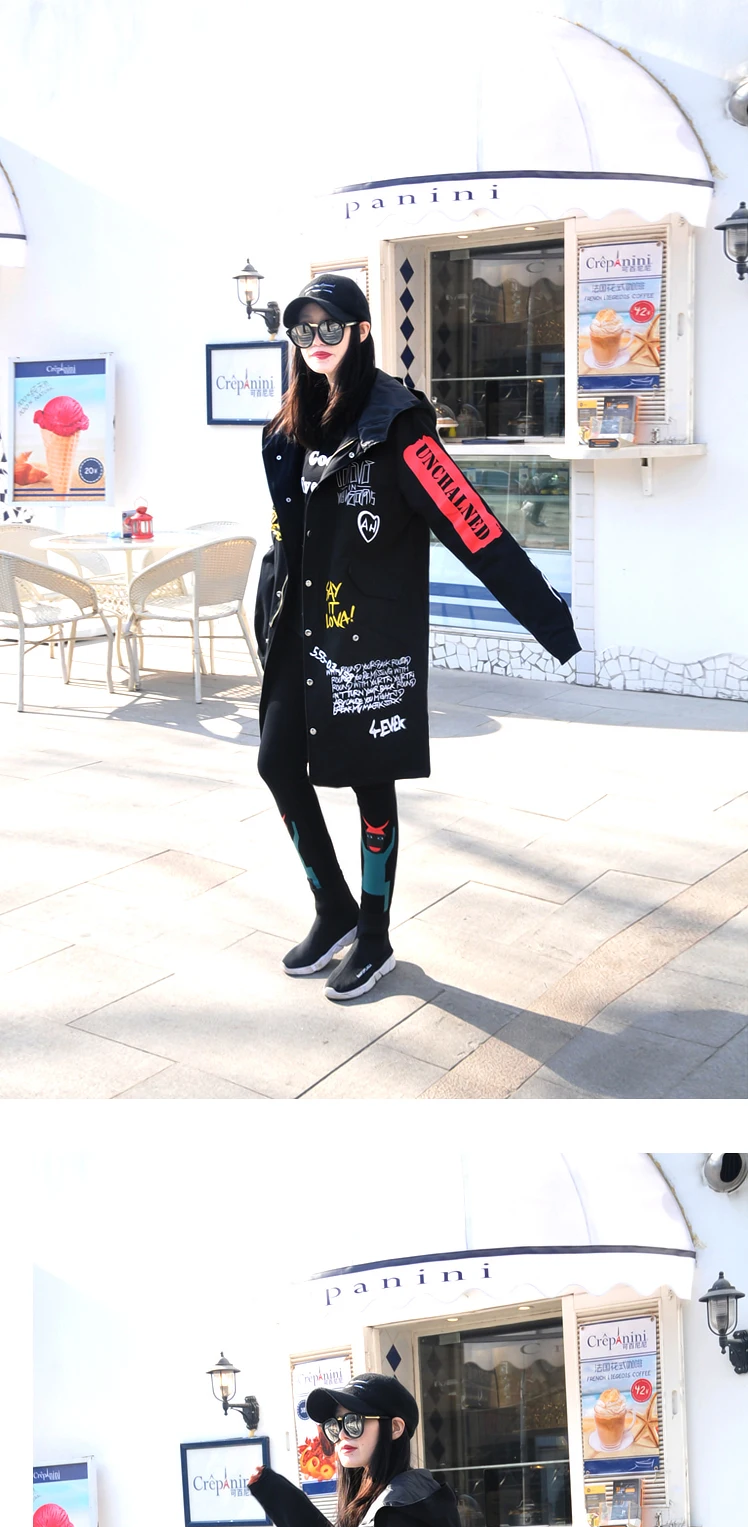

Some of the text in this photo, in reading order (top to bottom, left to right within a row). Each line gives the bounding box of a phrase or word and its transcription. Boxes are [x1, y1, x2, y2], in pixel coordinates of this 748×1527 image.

[345, 185, 500, 219] panini
[415, 443, 490, 540] UNCHALNED
[325, 1262, 492, 1306] panini
[631, 1370, 652, 1378] COFFEE
